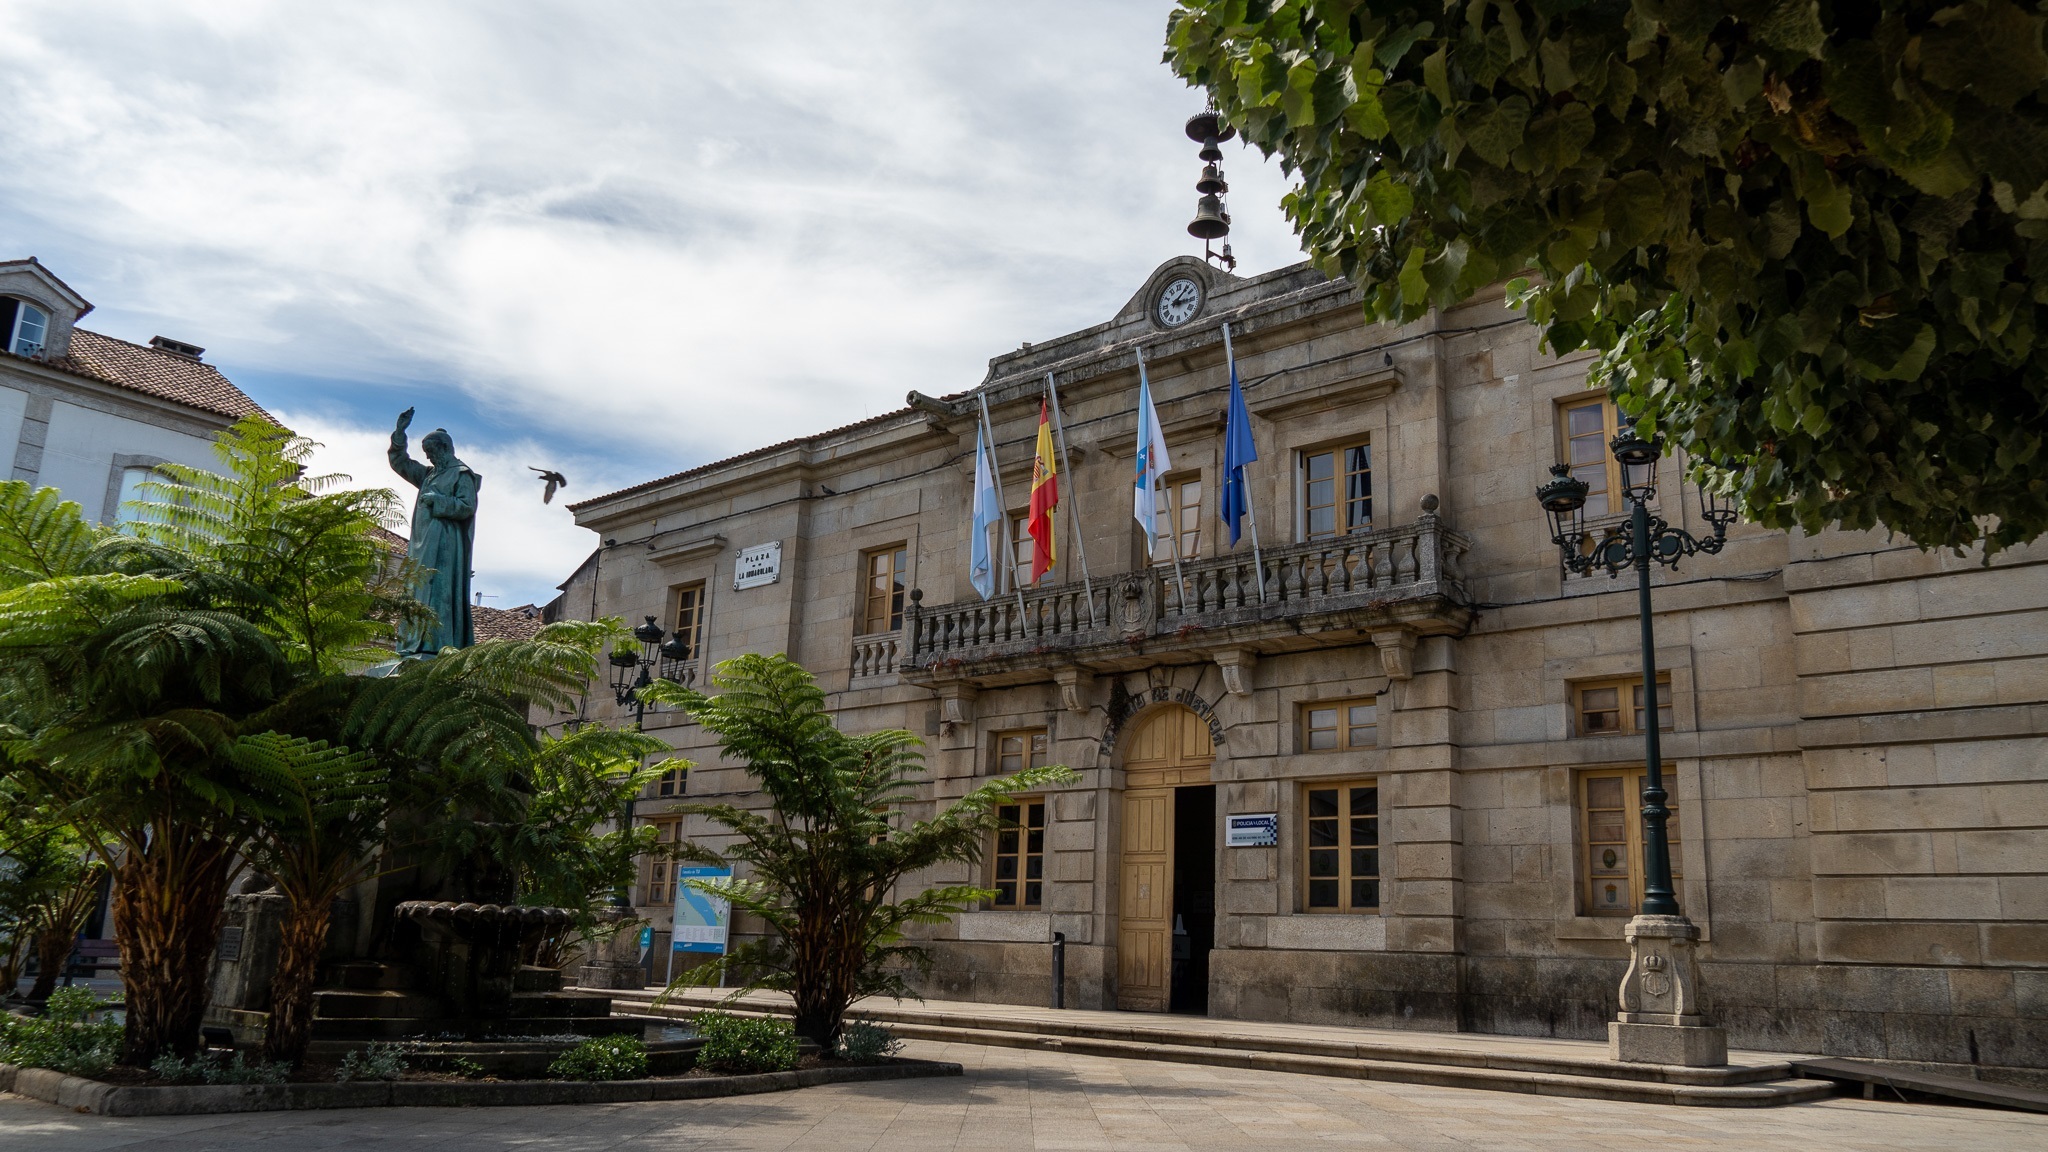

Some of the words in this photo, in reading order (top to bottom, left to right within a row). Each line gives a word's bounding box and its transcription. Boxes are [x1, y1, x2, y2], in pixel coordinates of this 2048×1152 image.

[745, 552, 770, 563] PLAZA
[1151, 686, 1169, 702] DE
[1174, 687, 1226, 747] JUSTICIA
